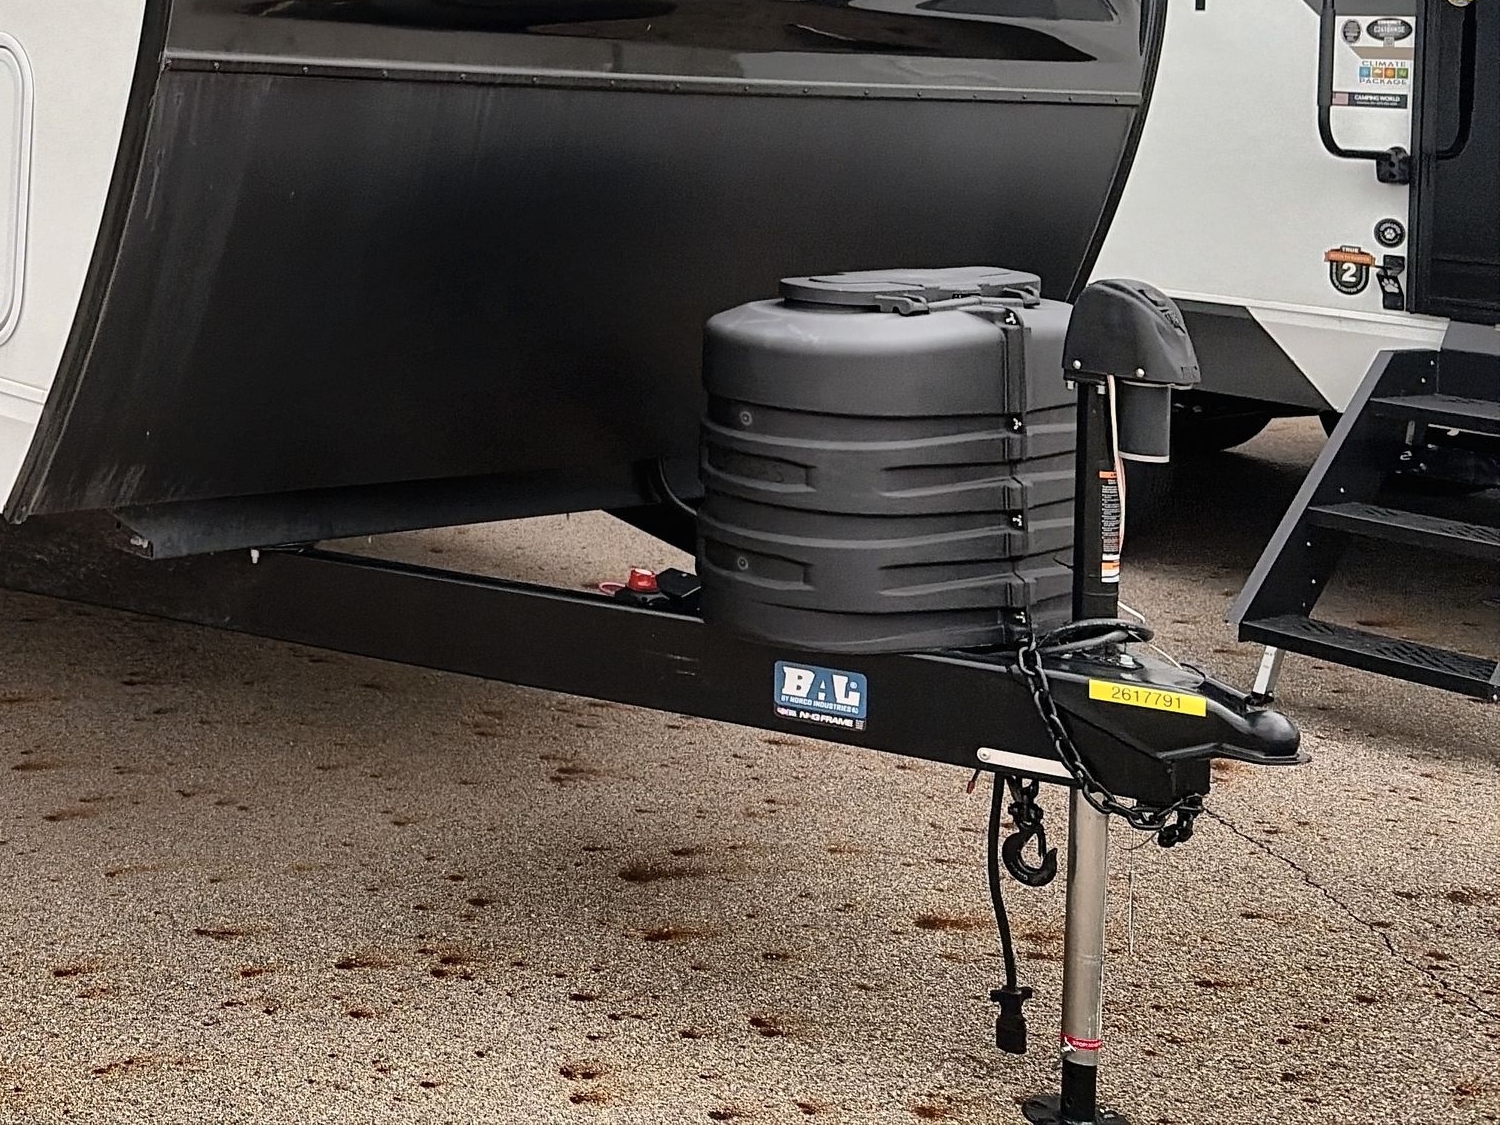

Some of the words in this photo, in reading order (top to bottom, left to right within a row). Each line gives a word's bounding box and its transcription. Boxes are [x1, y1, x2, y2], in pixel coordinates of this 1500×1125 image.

[1354, 94, 1379, 102] CAMPING
[1341, 262, 1357, 282] 2
[781, 666, 861, 707] BAL
[781, 695, 789, 703] BY
[789, 696, 813, 706] NORCO
[813, 700, 851, 713] INDUSTRIES
[1111, 686, 1181, 709] 2617791
[820, 715, 854, 728] FRAME
